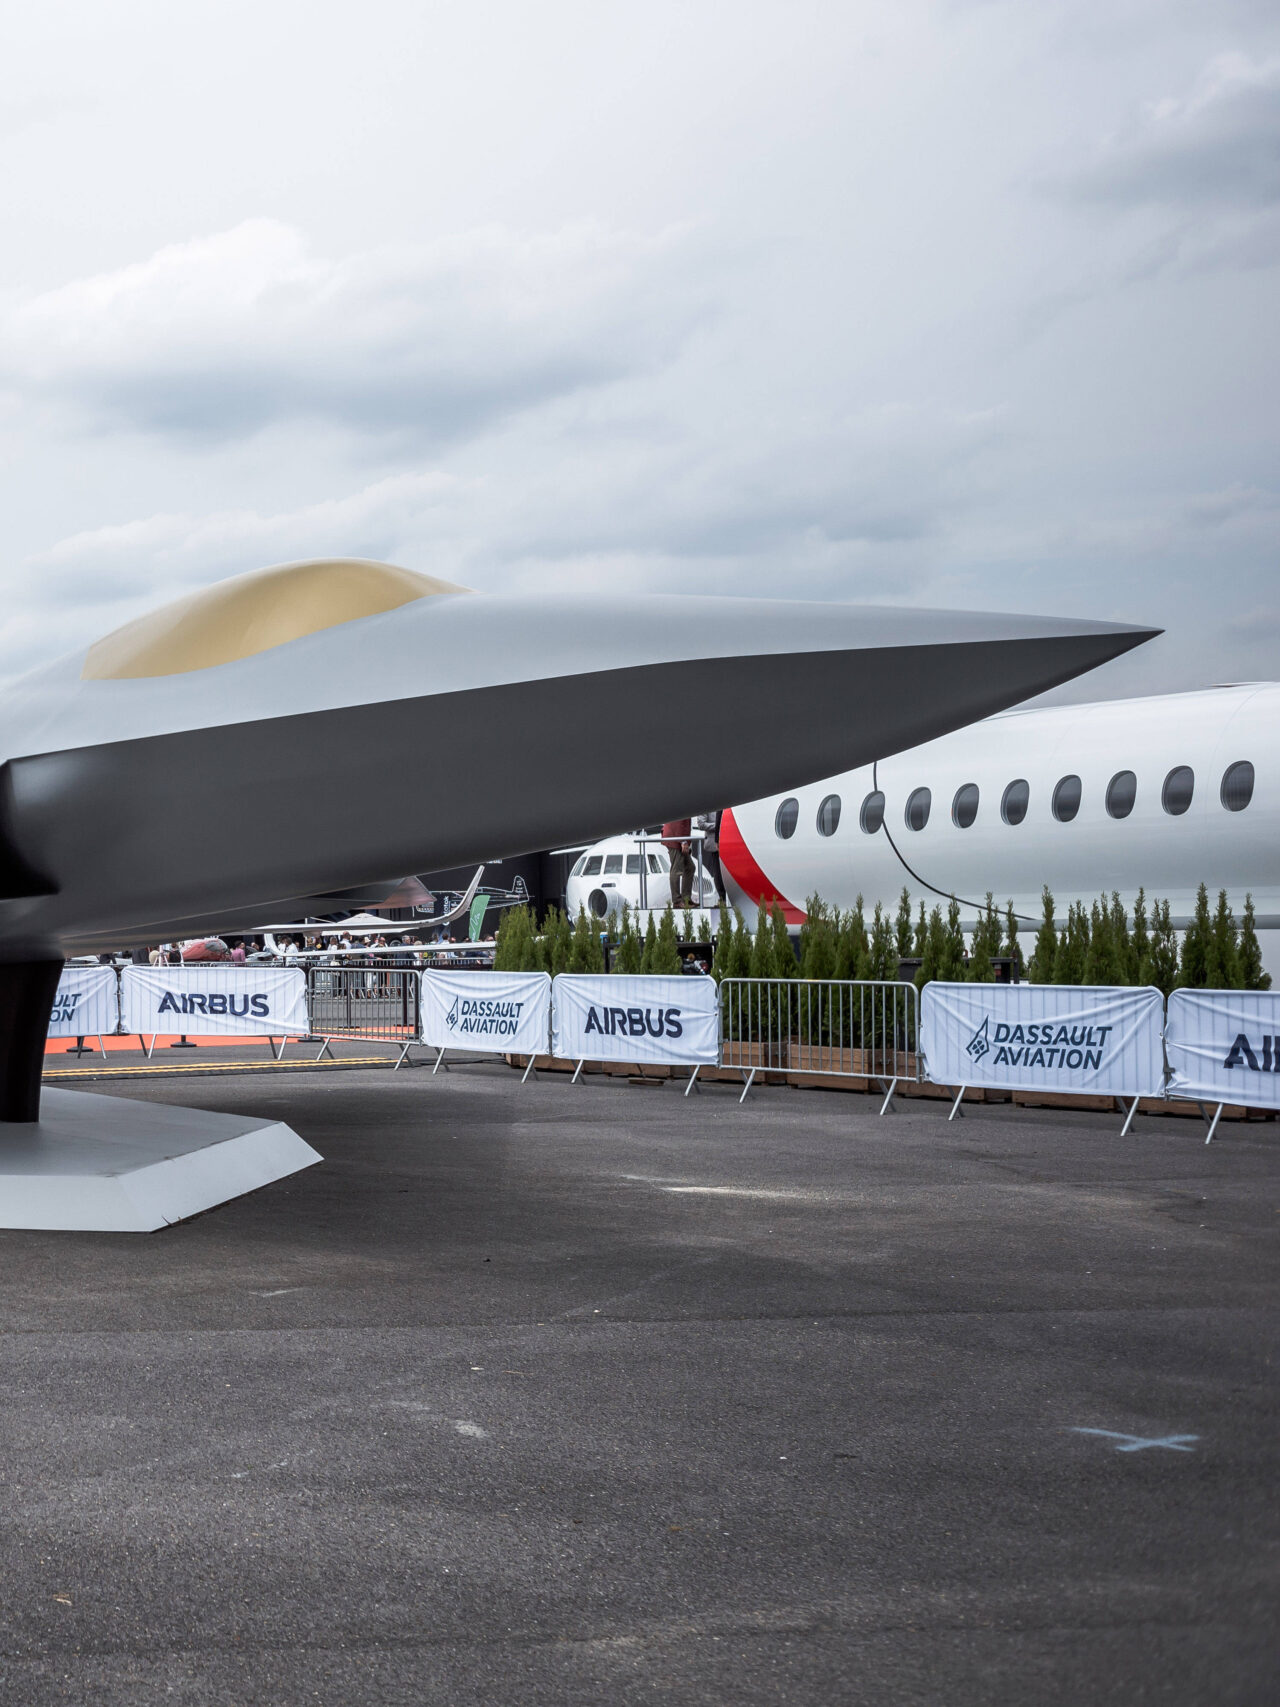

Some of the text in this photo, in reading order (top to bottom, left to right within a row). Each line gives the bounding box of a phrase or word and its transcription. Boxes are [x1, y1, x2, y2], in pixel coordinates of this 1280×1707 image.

[157, 991, 270, 1018] AIRBUS
[461, 1000, 524, 1019] DASSAULT
[460, 1017, 519, 1036] AVIATION
[584, 1006, 683, 1039] AIRBUS
[993, 1023, 1112, 1047] DASSAULT
[993, 1046, 1103, 1071] AVIATION
[1223, 1033, 1280, 1073] AI
